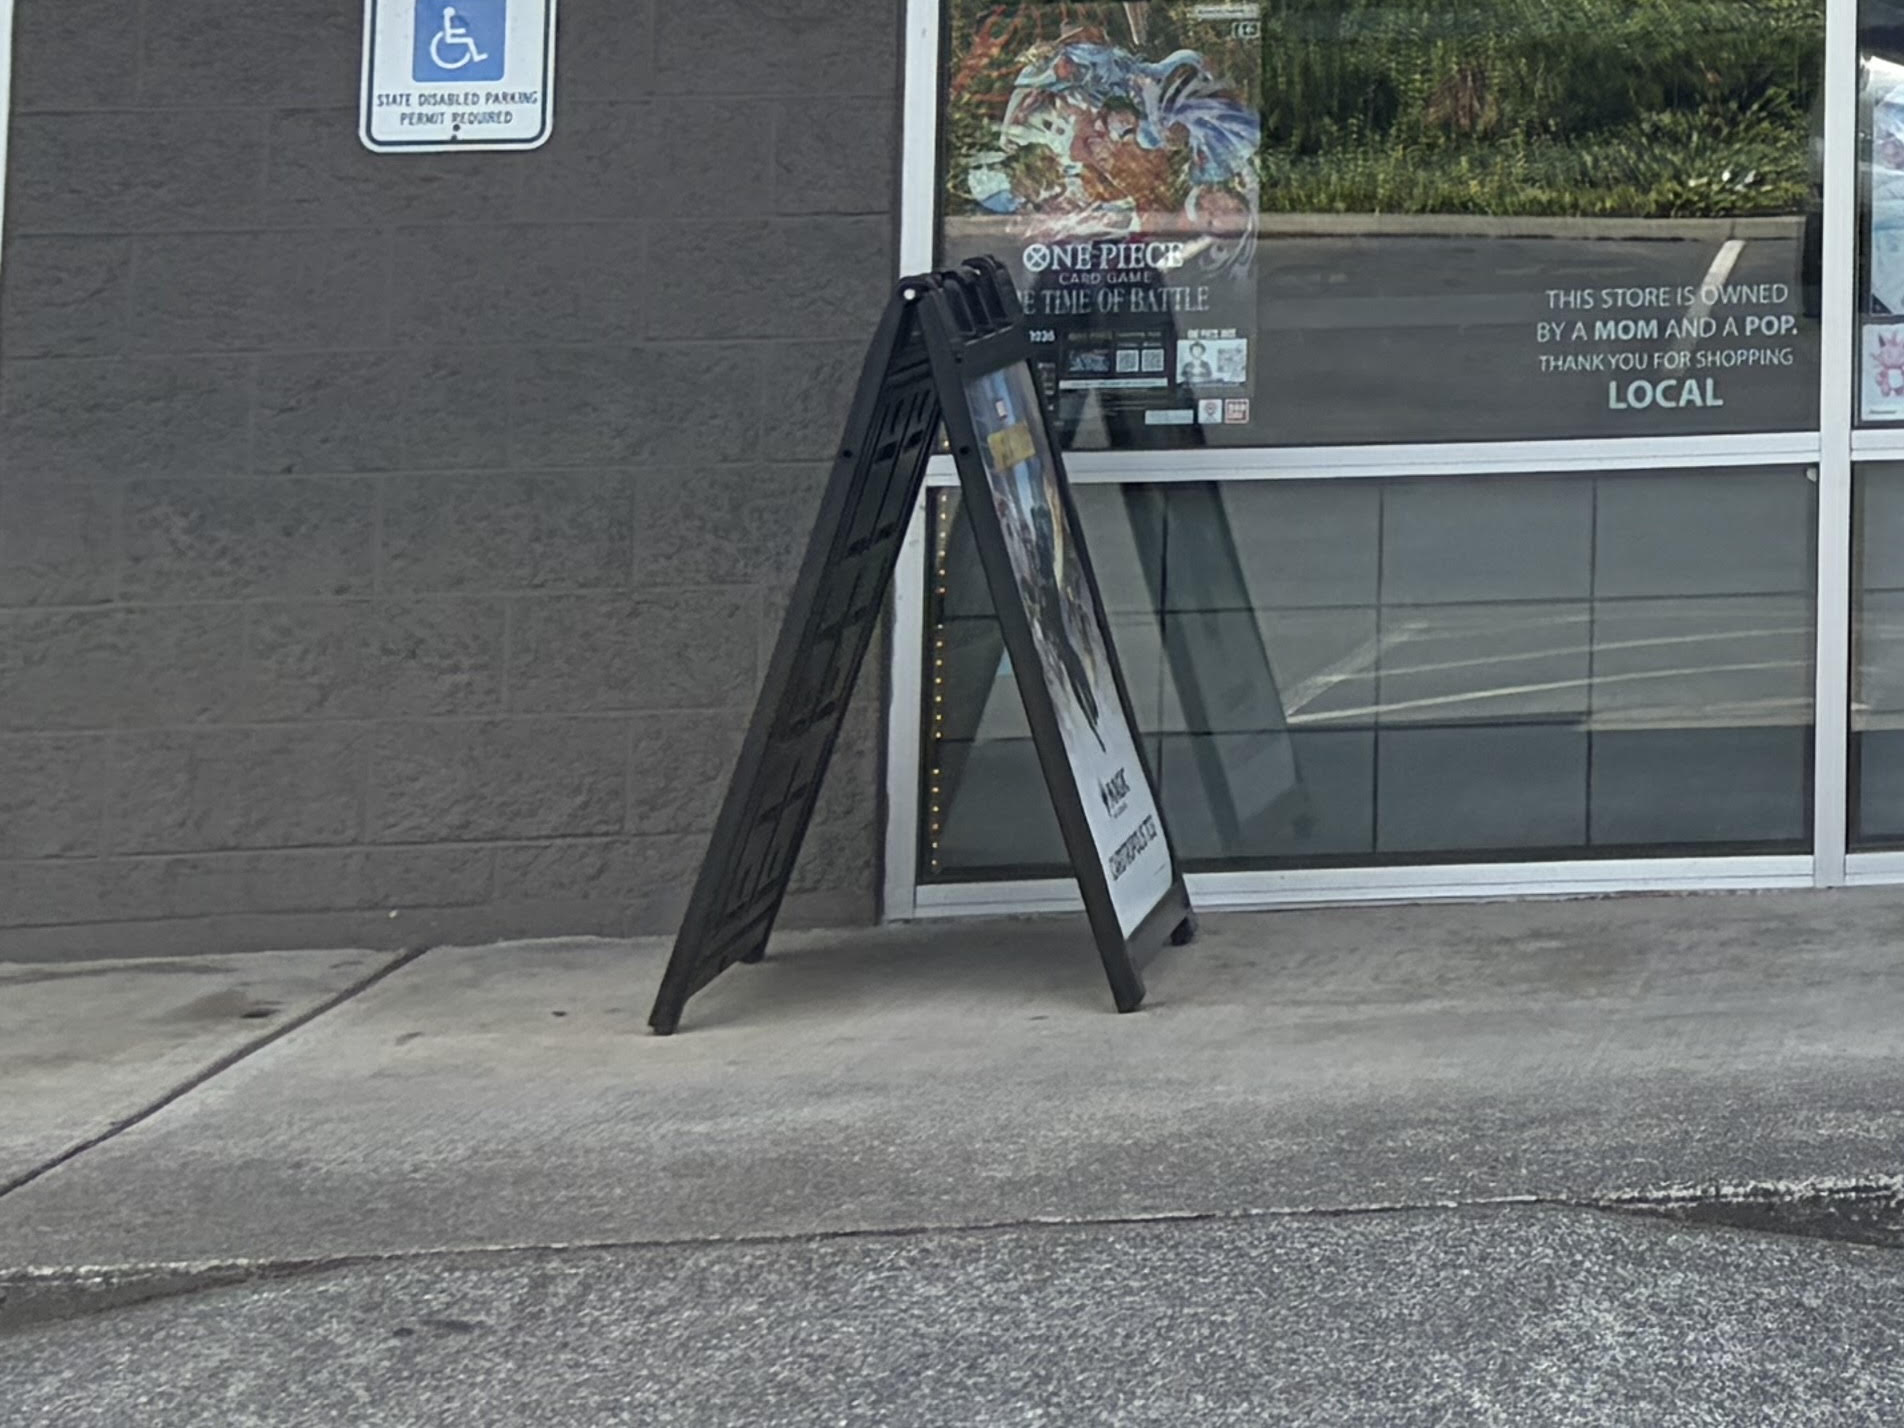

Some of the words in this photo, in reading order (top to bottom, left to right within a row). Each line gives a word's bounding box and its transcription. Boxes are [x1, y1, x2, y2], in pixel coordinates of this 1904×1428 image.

[376, 93, 411, 107] STATE
[418, 92, 479, 106] DISABLED
[485, 91, 538, 105] PARKING
[400, 112, 445, 126] PERMIT
[451, 111, 513, 125] REQUIRED
[1023, 243, 1091, 272] ONE
[1100, 242, 1184, 270] PIECE
[1059, 272, 1100, 285] CARD
[1107, 271, 1152, 284] GAME
[1041, 287, 1092, 315] TIME
[1099, 287, 1121, 314] OF
[1130, 286, 1211, 313] BATTLE
[1546, 290, 1594, 310] THIS
[1601, 287, 1670, 309] STORE
[1677, 286, 1695, 307] IS
[1702, 284, 1788, 305] OWNED
[1537, 323, 1563, 342] BY
[1572, 322, 1588, 341] A
[1594, 319, 1658, 341] MOM
[1665, 317, 1716, 339] AND
[1722, 316, 1738, 337] A
[1745, 314, 1798, 337] POP.
[1539, 353, 1604, 373] THANK
[1607, 350, 1649, 370] YOU
[1654, 349, 1691, 369] FOR
[1696, 347, 1793, 368] SHOPPING
[1608, 377, 1724, 410] LOCAL
